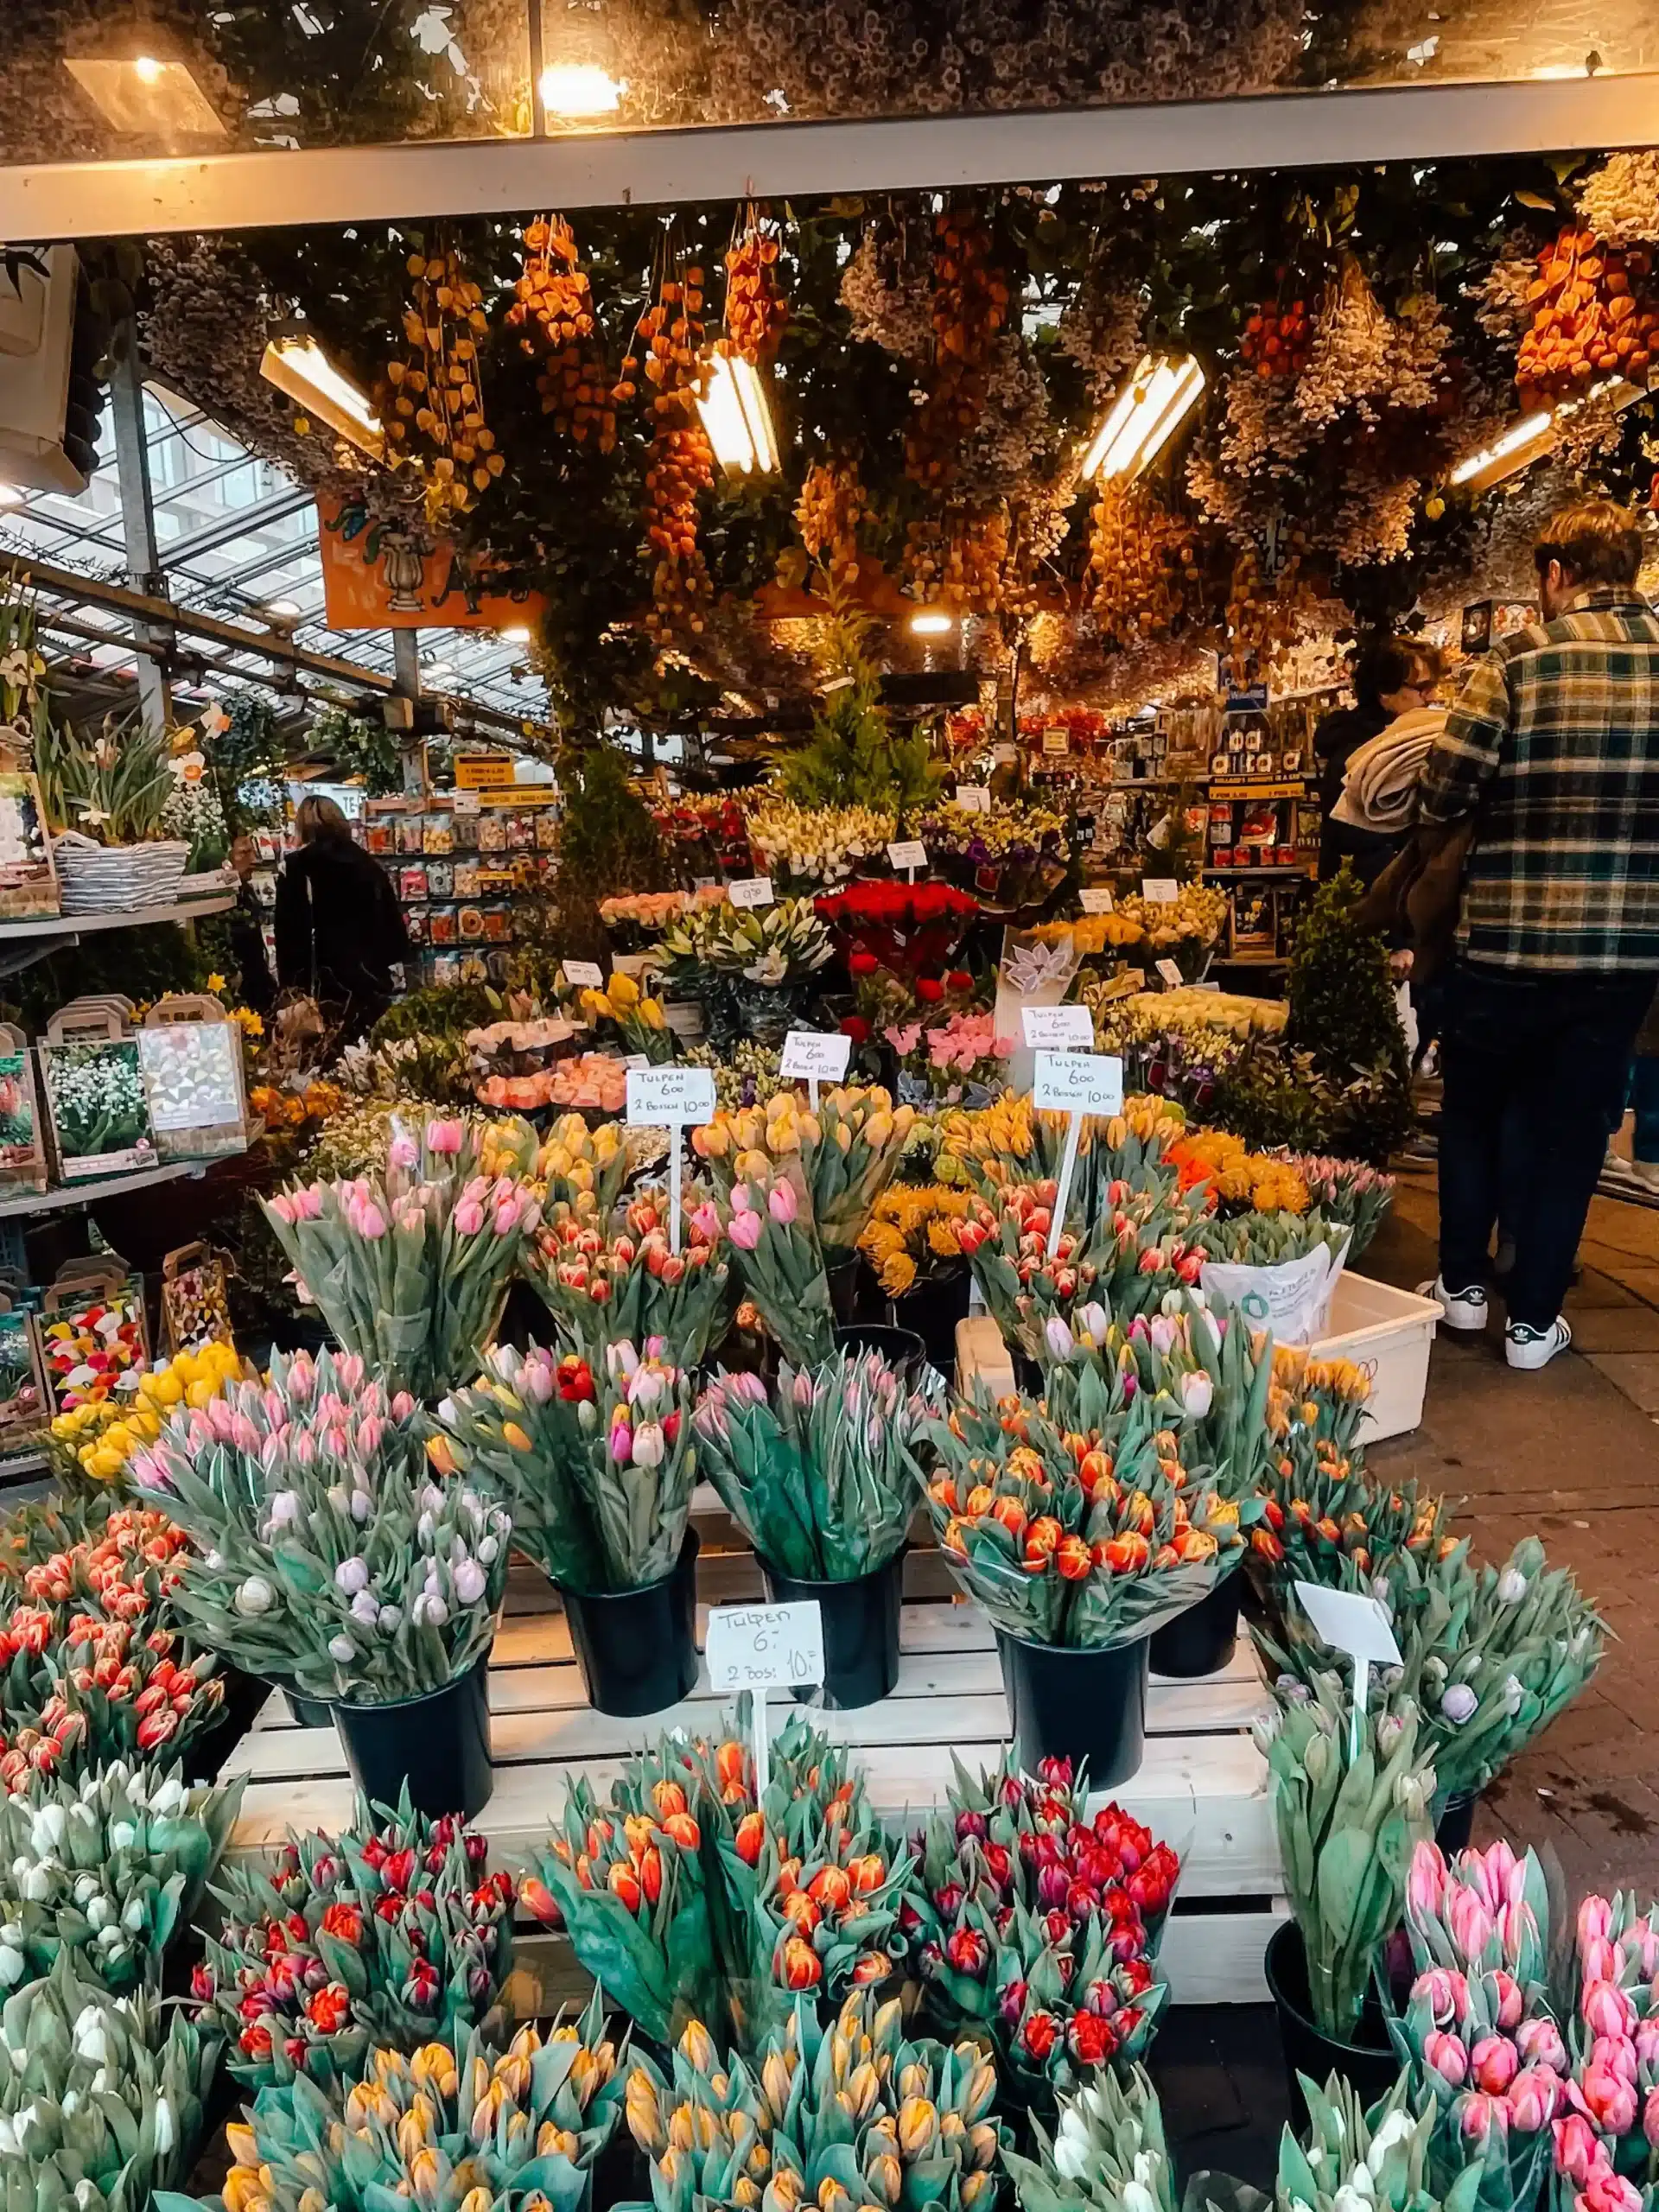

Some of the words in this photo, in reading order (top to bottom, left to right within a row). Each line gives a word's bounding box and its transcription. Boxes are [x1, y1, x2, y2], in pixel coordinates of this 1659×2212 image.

[1030, 1030, 1038, 1039] 2
[785, 1058, 792, 1068] 2
[636, 1073, 683, 1083] TULPEN
[1042, 1084, 1051, 1096] 2
[634, 1098, 642, 1110] 2
[727, 1666, 740, 1681] 2
